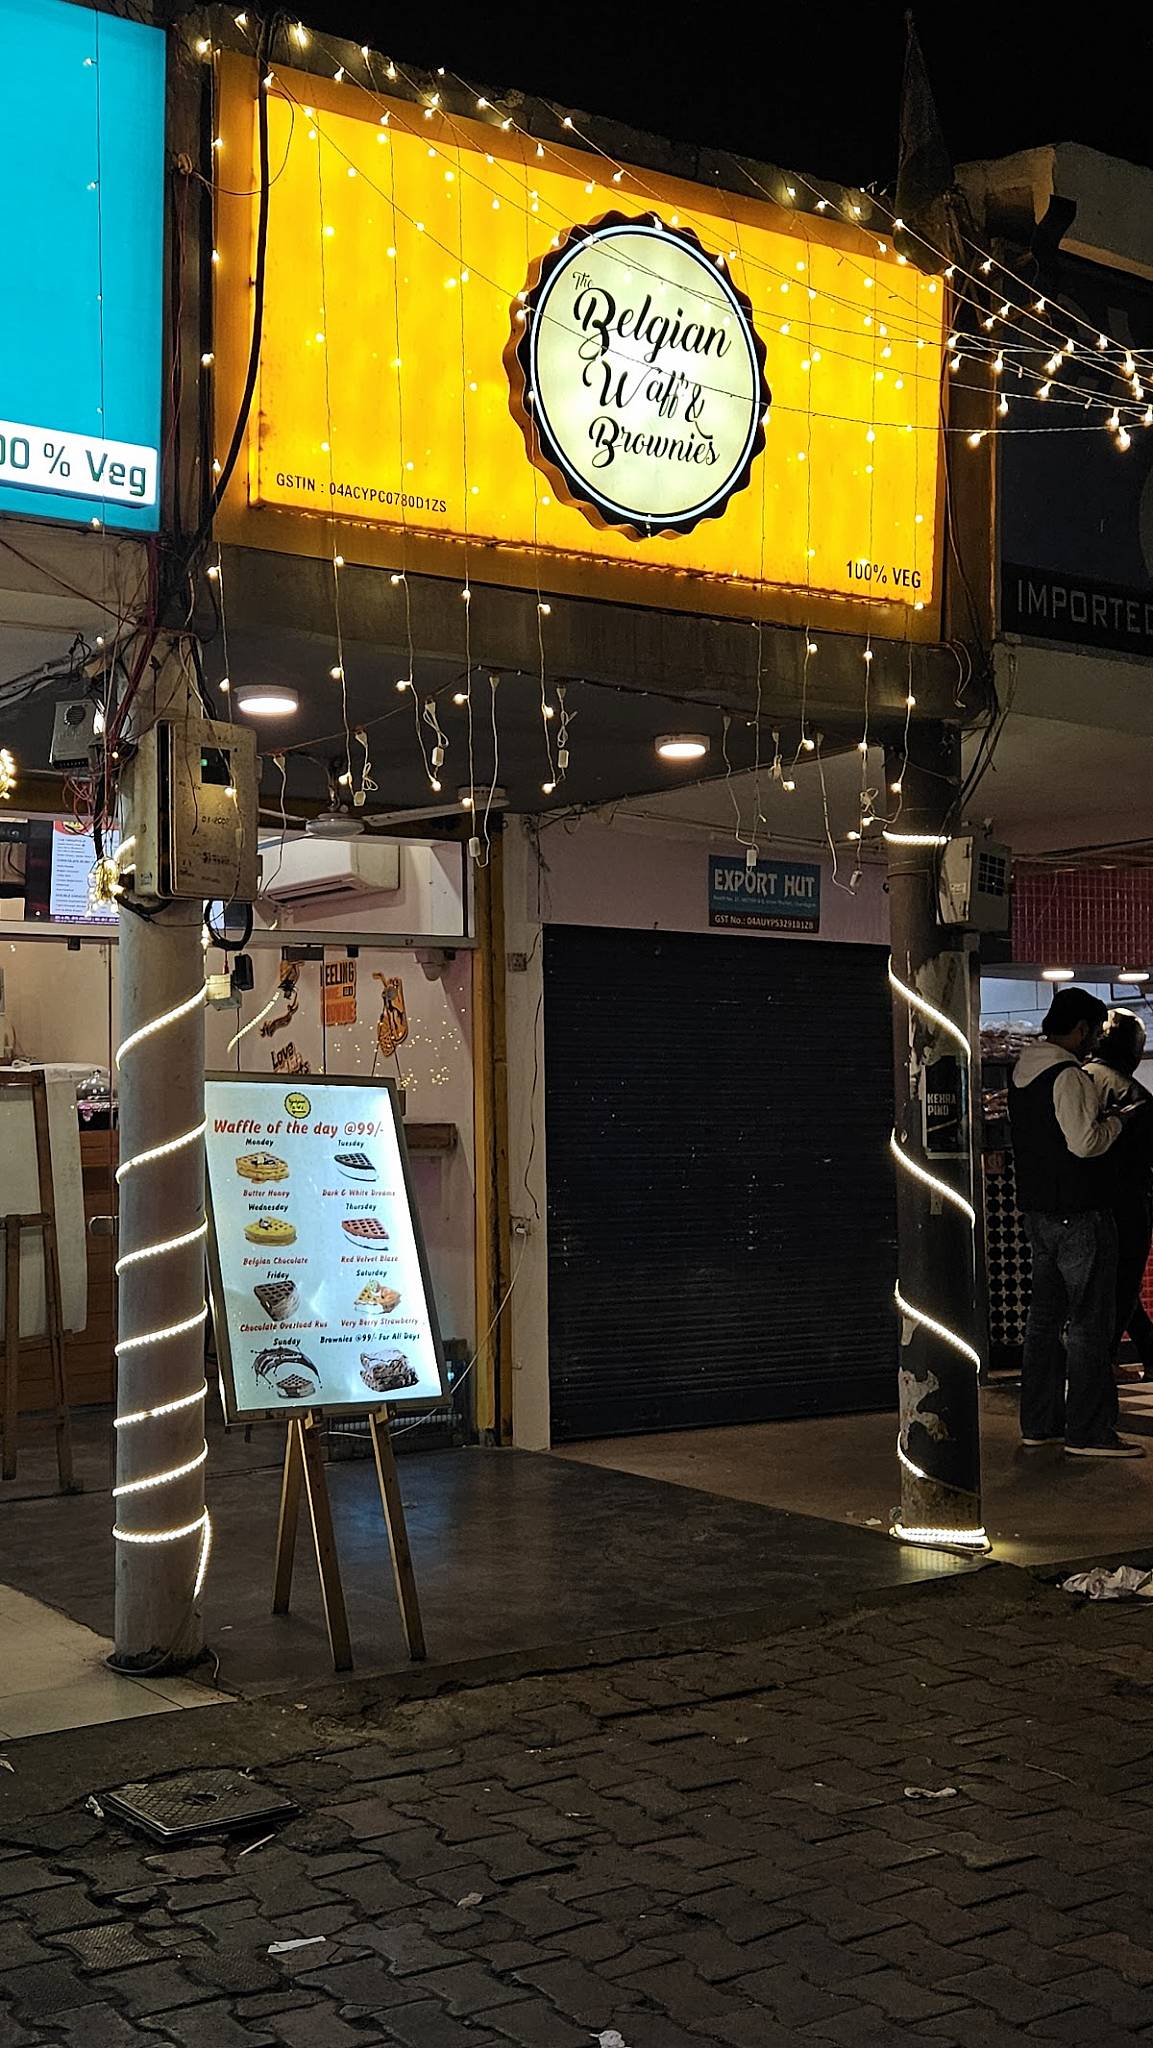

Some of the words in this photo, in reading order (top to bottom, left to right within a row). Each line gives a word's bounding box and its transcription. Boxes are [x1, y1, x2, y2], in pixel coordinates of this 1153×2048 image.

[572, 271, 593, 292] The
[573, 288, 731, 363] Belgian
[588, 416, 721, 489] Brownies
[0, 433, 30, 470] 0
[44, 442, 71, 477] %
[85, 449, 146, 497] Veg
[276, 472, 316, 492] GSTIN
[329, 481, 447, 513] 04ACYPC0780D1ZS
[846, 560, 887, 584] 100%
[892, 567, 921, 589] VEG
[714, 867, 778, 897] EXPORT
[783, 873, 816, 898] HUT
[714, 914, 729, 924] GST
[214, 1119, 262, 1135] Waffle
[266, 1120, 283, 1134] of
[286, 1120, 308, 1135] the
[313, 1121, 338, 1139] day
[344, 1121, 384, 1138] @99/-
[245, 1138, 274, 1148] Monday
[337, 1139, 365, 1148] Tuesday
[243, 1189, 266, 1197] Butter
[268, 1189, 290, 1199] Honey
[322, 1188, 338, 1197] Dark
[349, 1188, 369, 1197] White
[248, 1203, 289, 1213] Wednesday
[345, 1202, 377, 1212] Thursday
[243, 1257, 271, 1267] Belgian
[273, 1256, 309, 1265] Chocolate
[341, 1255, 355, 1263] Red
[356, 1255, 378, 1263] Velvet
[266, 1270, 290, 1280] Friday
[355, 1269, 388, 1278] Saturday
[239, 1321, 278, 1333] Chocolate
[341, 1319, 357, 1329] Very
[359, 1318, 378, 1327] Berry
[380, 1317, 418, 1326] Strawberry
[272, 1337, 301, 1347] Sunday
[319, 1334, 354, 1344] Brownies
[378, 1332, 390, 1341] For
